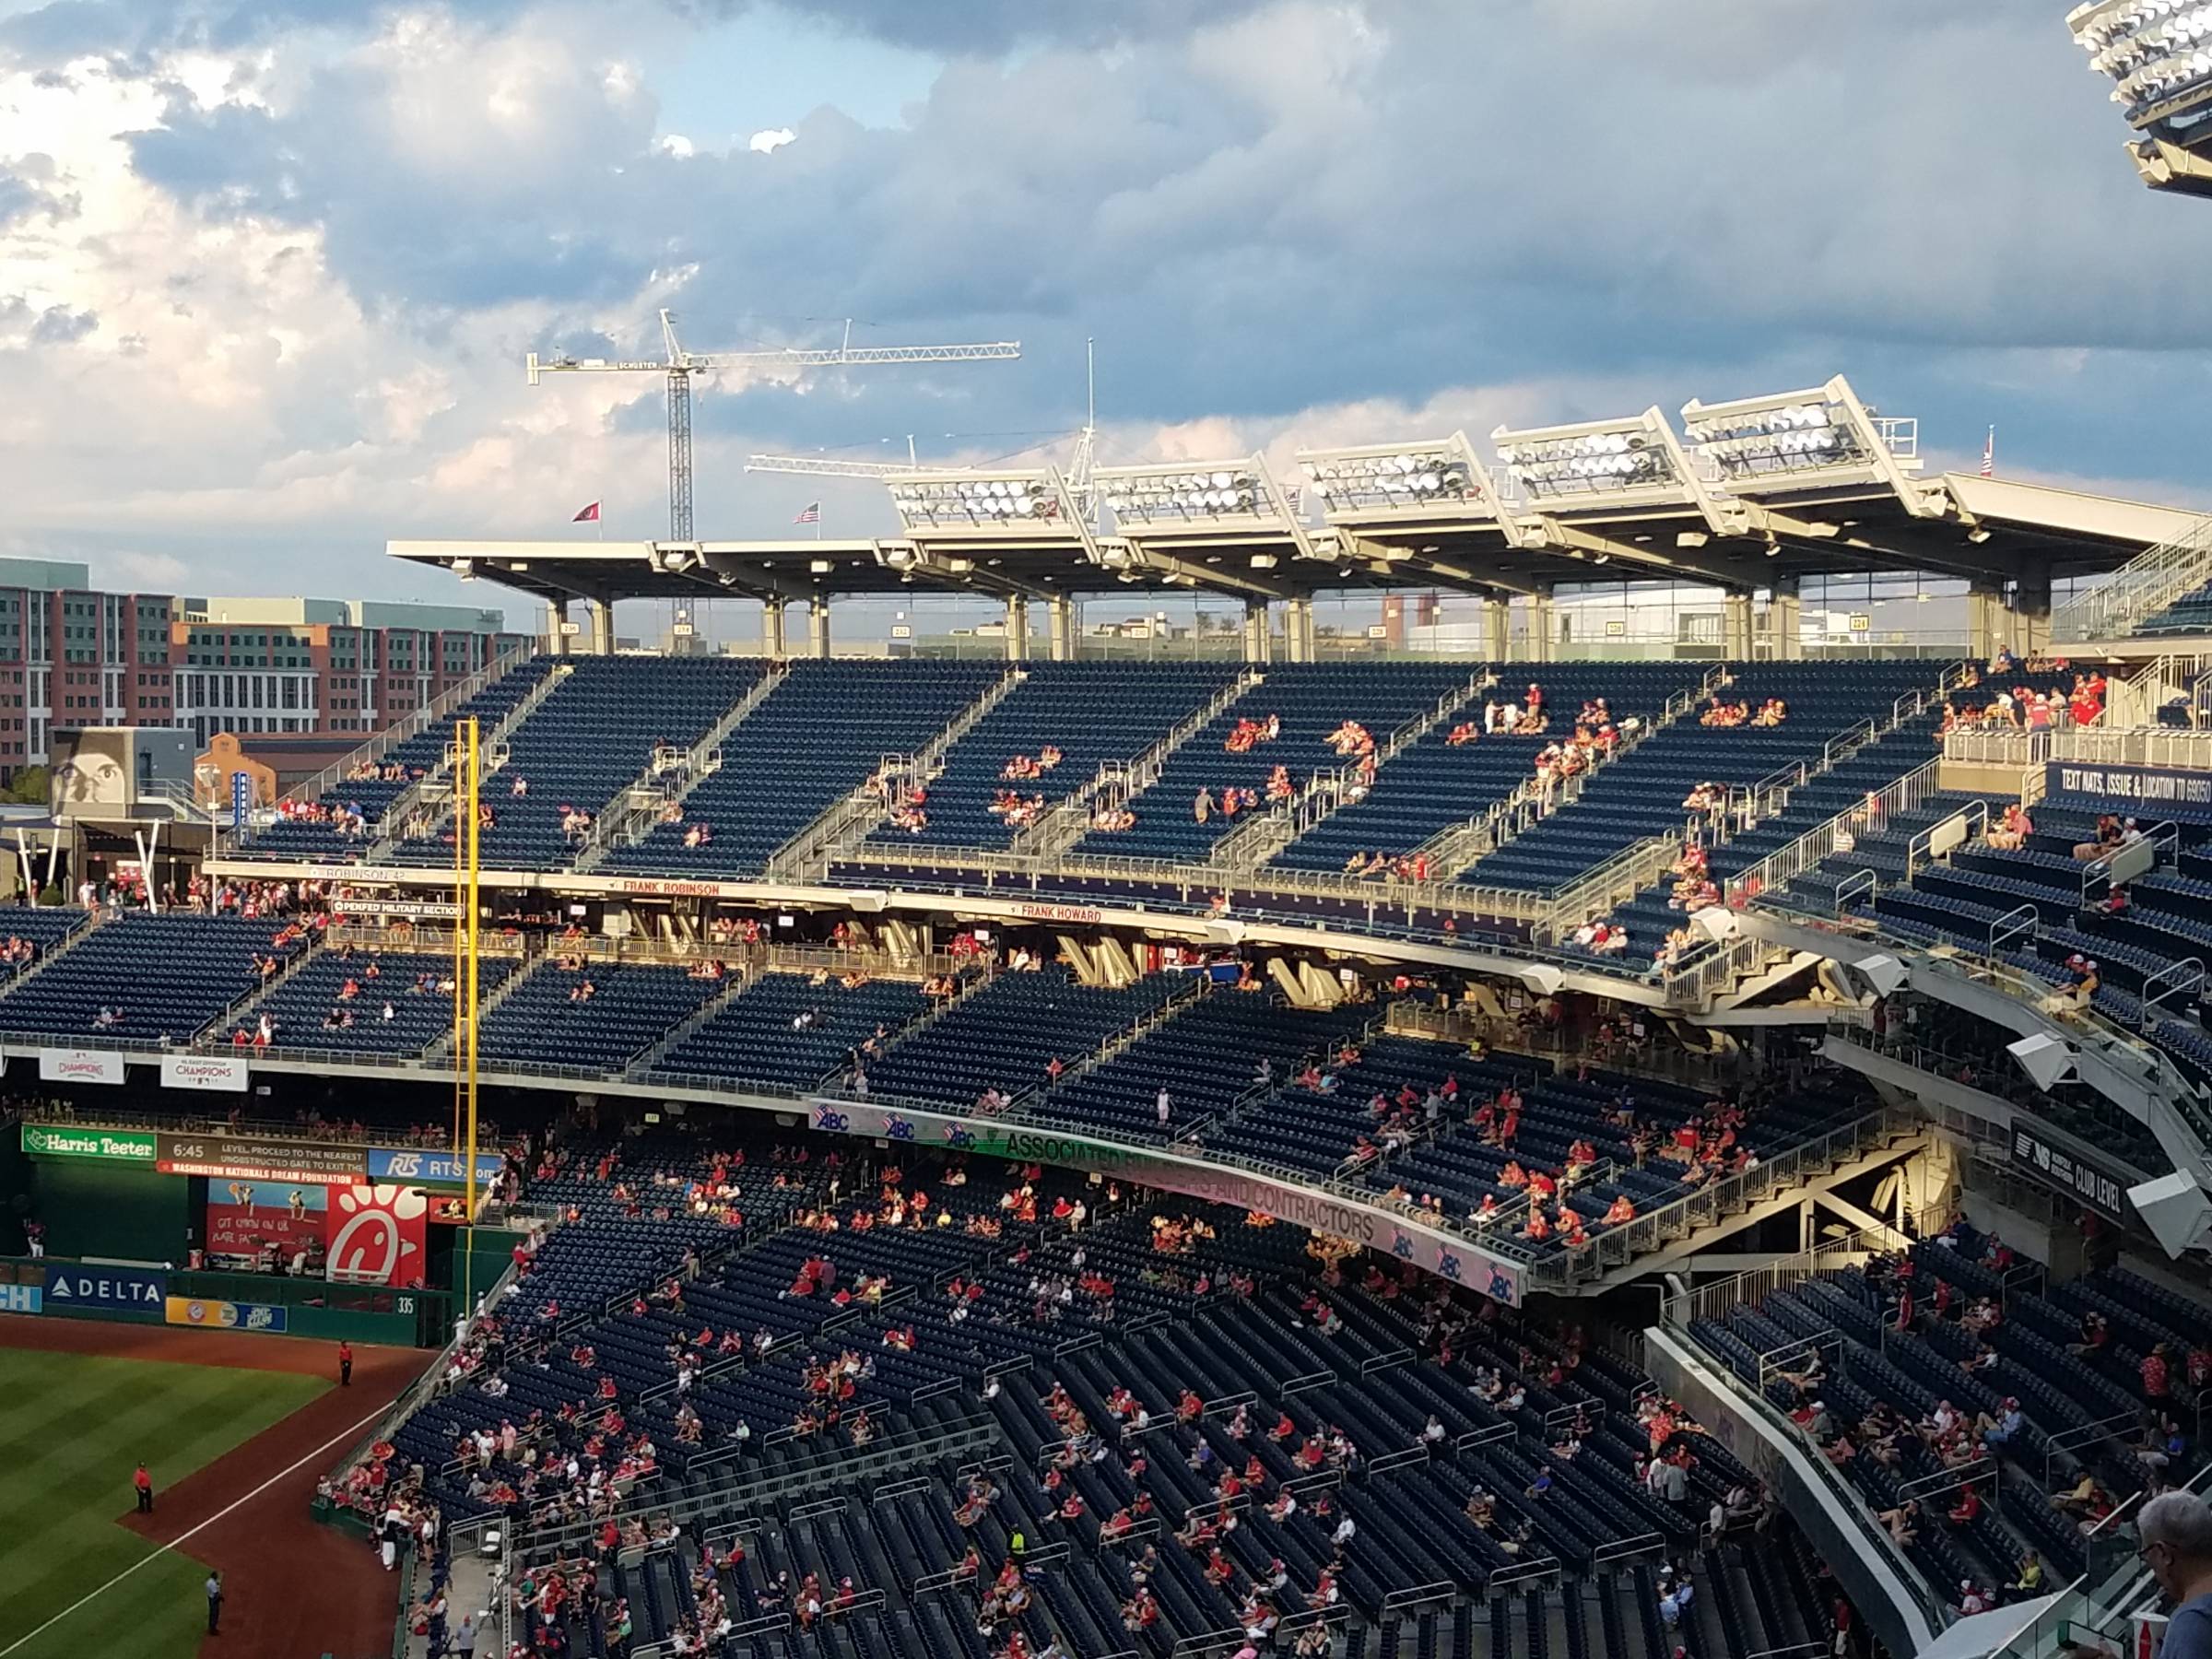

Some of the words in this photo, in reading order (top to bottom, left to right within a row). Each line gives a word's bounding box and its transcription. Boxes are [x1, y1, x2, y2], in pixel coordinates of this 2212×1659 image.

[2062, 769, 2081, 791] TEXT
[2082, 771, 2105, 797] NATS,
[2107, 772, 2132, 796] ISSUE
[2134, 775, 2141, 797] &
[2143, 776, 2174, 800] LOCATION
[2176, 778, 2185, 801] TO
[2186, 779, 2211, 803] 69050
[326, 868, 388, 880] ROBINSON
[624, 880, 659, 892] FRANK
[664, 883, 720, 896] ROBINSON
[382, 904, 421, 913] MILITARY
[1022, 905, 1055, 918] FRANK
[1057, 907, 1101, 922] HOWARD
[59, 1062, 103, 1076] CHAMPIONS
[175, 1065, 231, 1077] CHAMPIONS
[818, 1112, 849, 1131] ABC
[886, 1120, 915, 1140] ABC
[47, 1135, 97, 1152] Harris
[100, 1138, 153, 1157] Teeter
[947, 1131, 976, 1151] ABC
[172, 1144, 205, 1159] 6:45
[292, 1149, 304, 1159] TO
[306, 1149, 322, 1159] THE
[324, 1151, 362, 1161] NEAREST
[173, 1163, 224, 1175] WASHINGTON
[226, 1167, 269, 1179] NATIONALS
[271, 1170, 300, 1181] DREAM
[301, 1172, 352, 1184] FOUNDATION
[289, 1159, 312, 1169] GATE
[313, 1160, 324, 1170] TO
[326, 1161, 346, 1171] EXIT
[347, 1162, 363, 1172] THE
[387, 1153, 423, 1177] RTS
[429, 1160, 495, 1179] RTS.om
[2076, 1164, 2095, 1198] CLUB
[2097, 1175, 2121, 1214] LEVEL
[1253, 1185, 1374, 1241] CONTRACTORS
[1393, 1234, 1414, 1259] ABC
[1438, 1254, 1461, 1280] ABC
[78, 1278, 160, 1302] DELTA
[1488, 1275, 1512, 1302] ABC
[397, 1297, 414, 1314] 335
